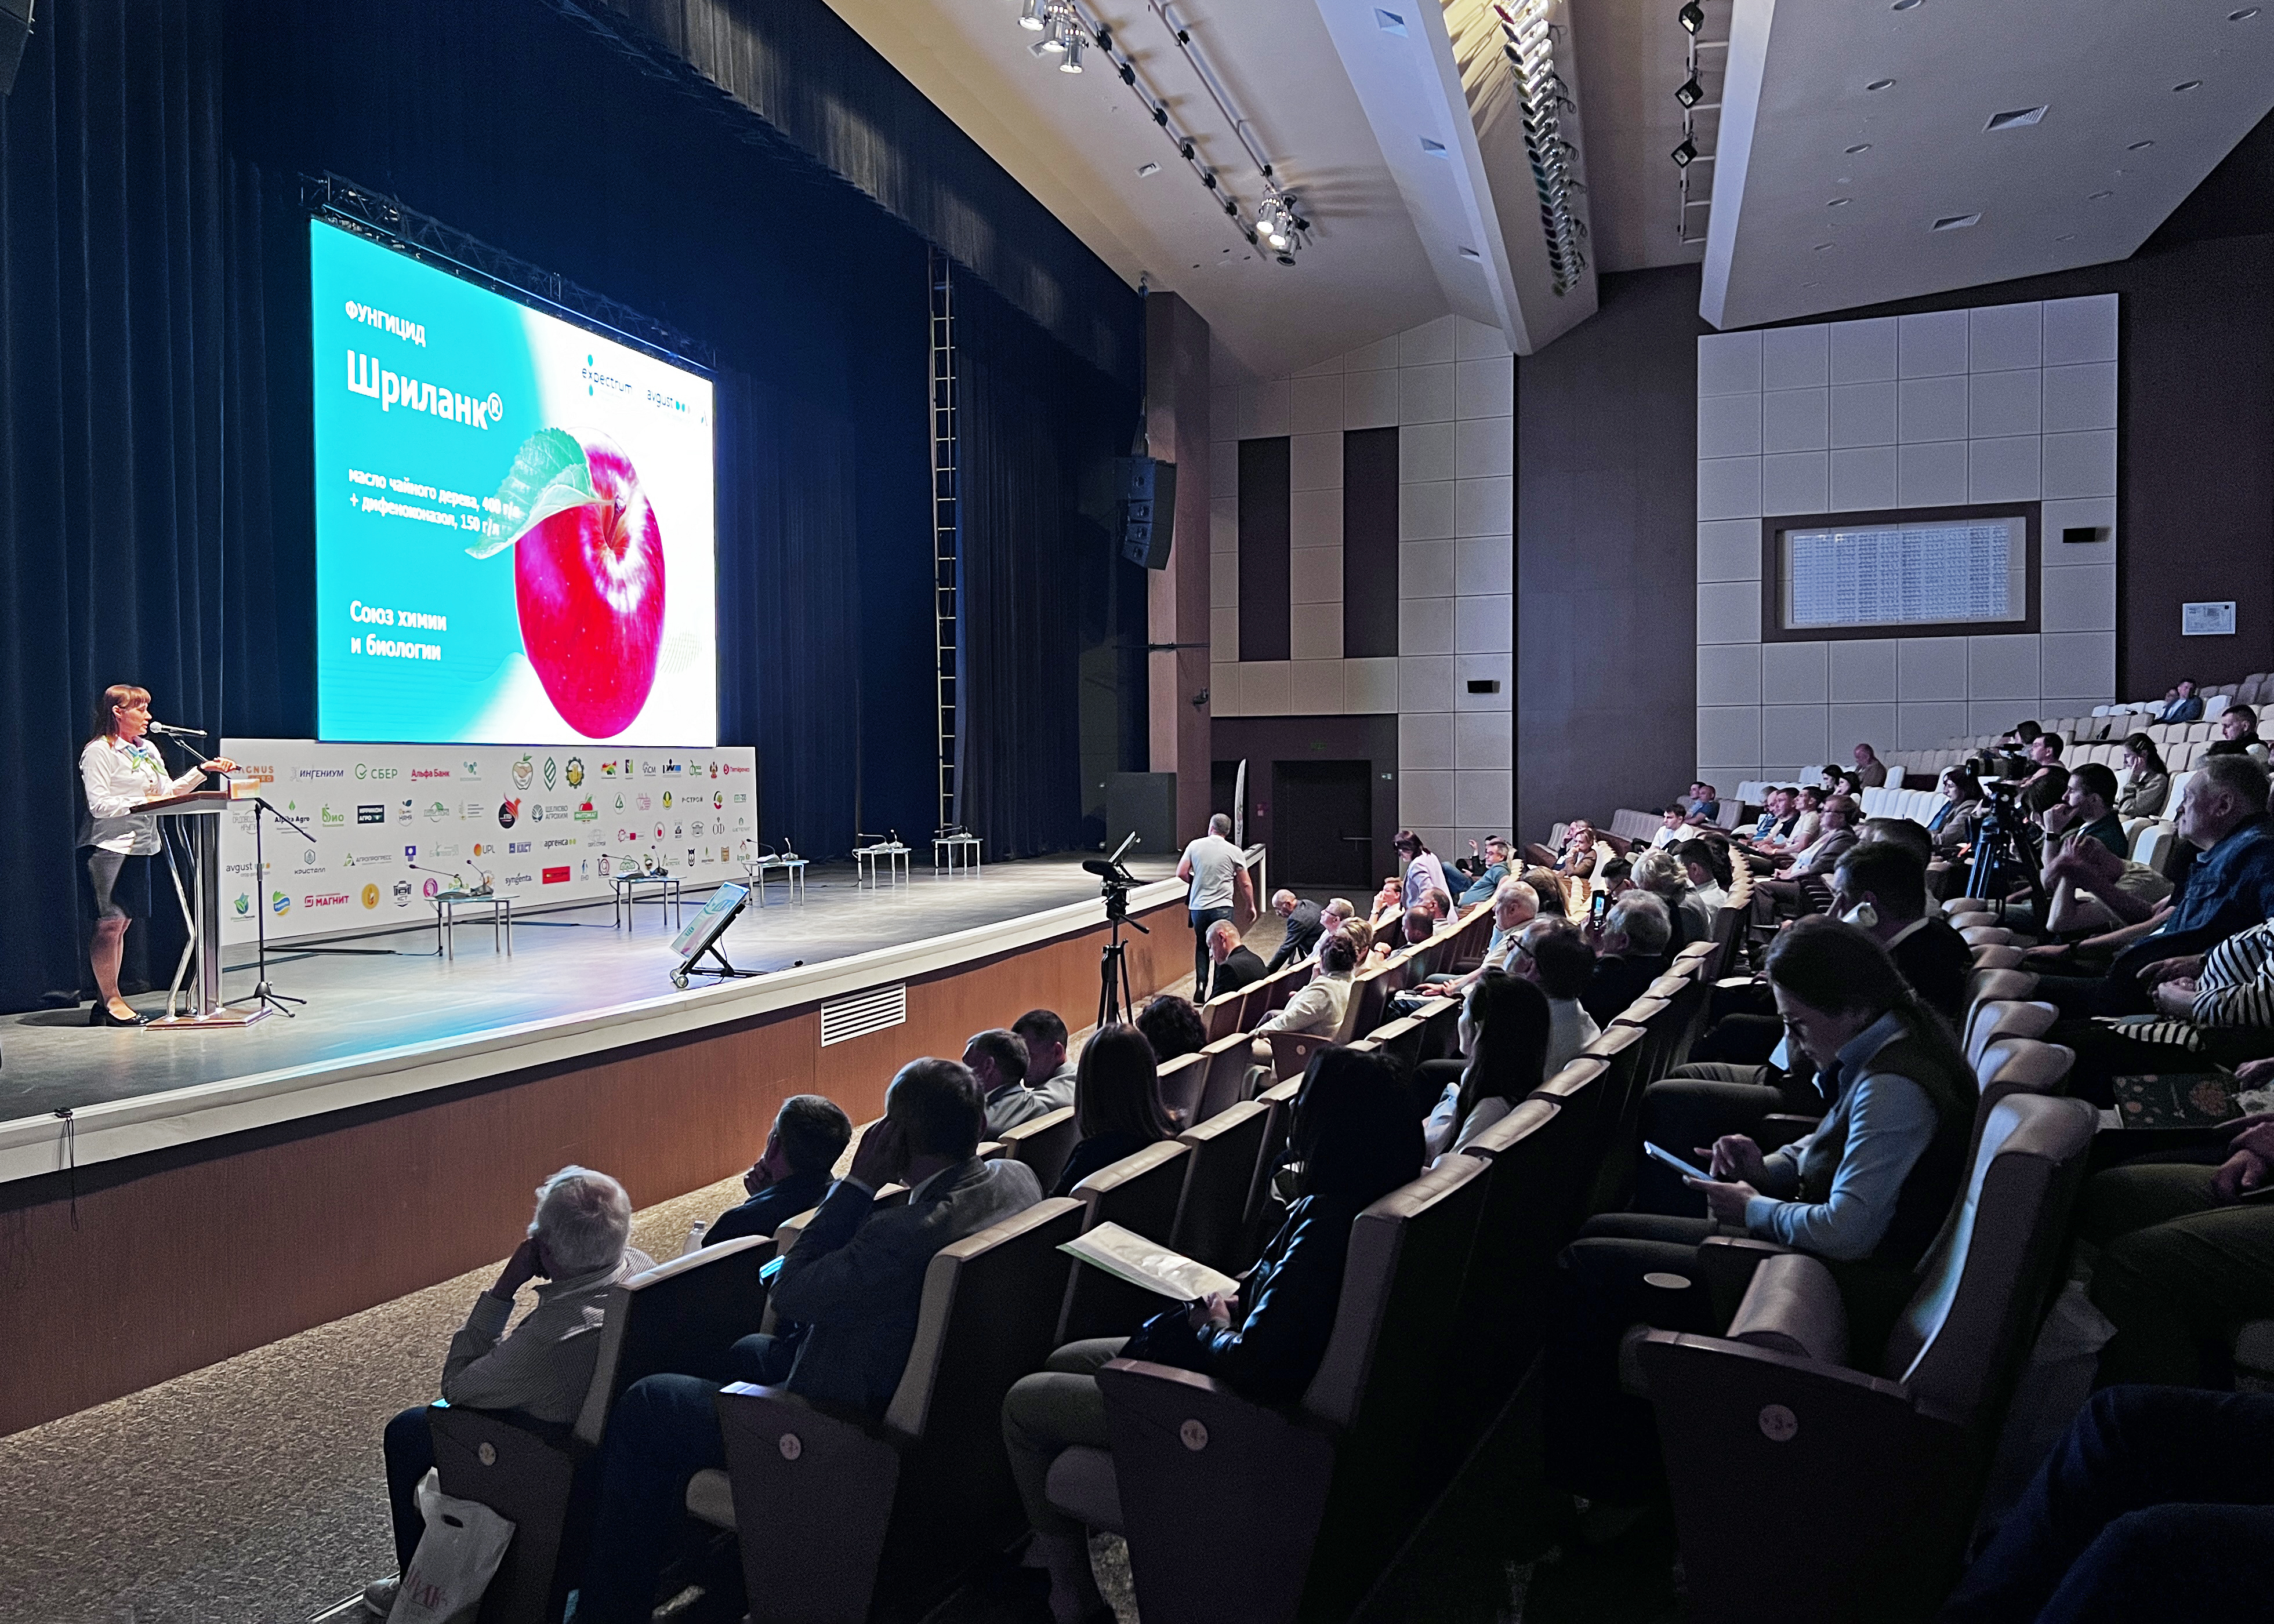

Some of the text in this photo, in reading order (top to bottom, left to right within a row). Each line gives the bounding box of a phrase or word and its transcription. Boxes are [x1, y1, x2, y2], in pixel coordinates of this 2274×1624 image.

[345, 300, 426, 348] ФУНГИЦИД
[582, 368, 632, 395] expectrum
[647, 390, 673, 408] avgust
[349, 468, 387, 489] масло
[389, 477, 437, 500] чайного
[438, 489, 480, 513] дерева,
[482, 496, 502, 514] 400
[350, 493, 499, 537] + дифеноконазол, 150 г/л
[350, 600, 447, 632] Союз химии
[351, 633, 441, 661] и биологии
[230, 765, 274, 774] AGNUS
[300, 770, 344, 779] ИНГЕНИУМ
[371, 769, 398, 779] СБЕР
[411, 769, 450, 779] Альфа Банк
[483, 844, 495, 854] UPL
[544, 838, 568, 849] аргенса
[226, 862, 252, 874] avgust
[505, 874, 532, 886] syngenta
[315, 895, 349, 907] МАГНИТ
